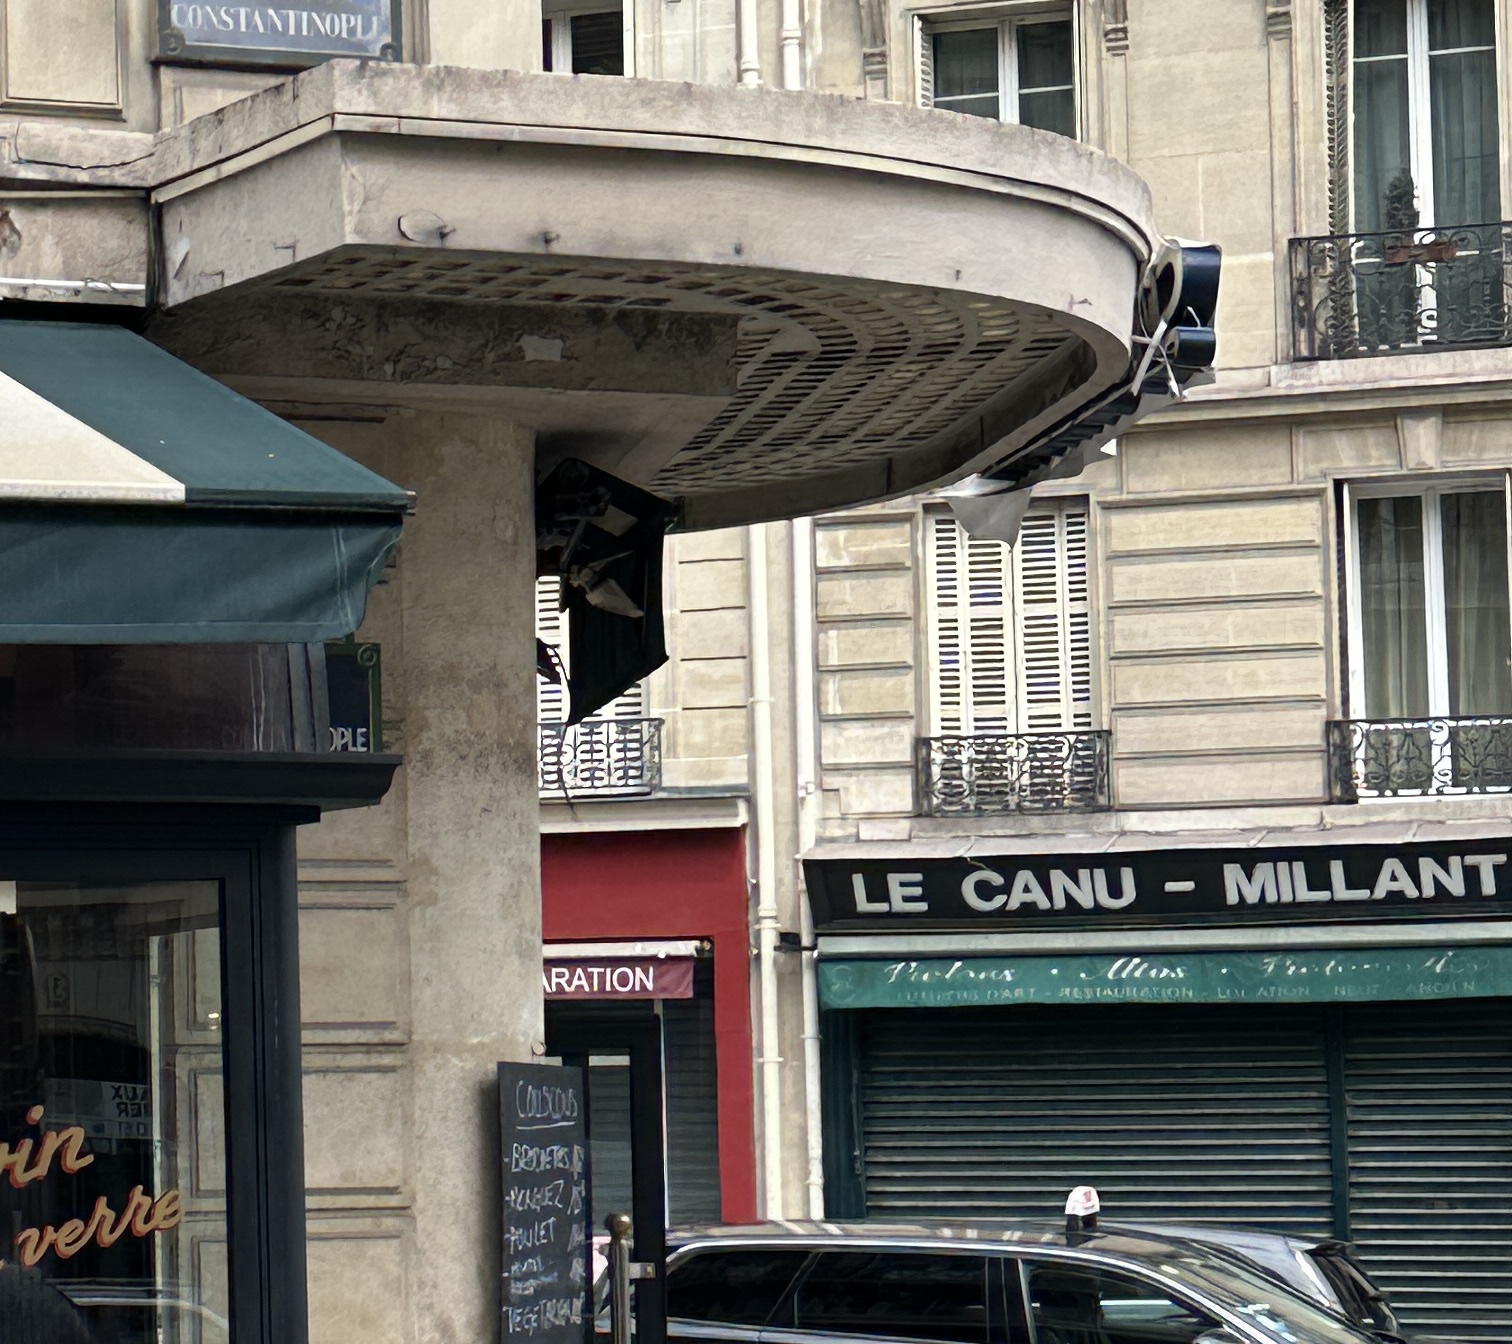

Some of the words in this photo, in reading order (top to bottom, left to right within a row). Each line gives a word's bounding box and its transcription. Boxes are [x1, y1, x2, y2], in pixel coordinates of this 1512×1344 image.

[852, 872, 928, 913] LE
[961, 867, 1137, 912] CANU
[1223, 853, 1507, 905] MILLANT
[14, 1184, 183, 1268] verre
